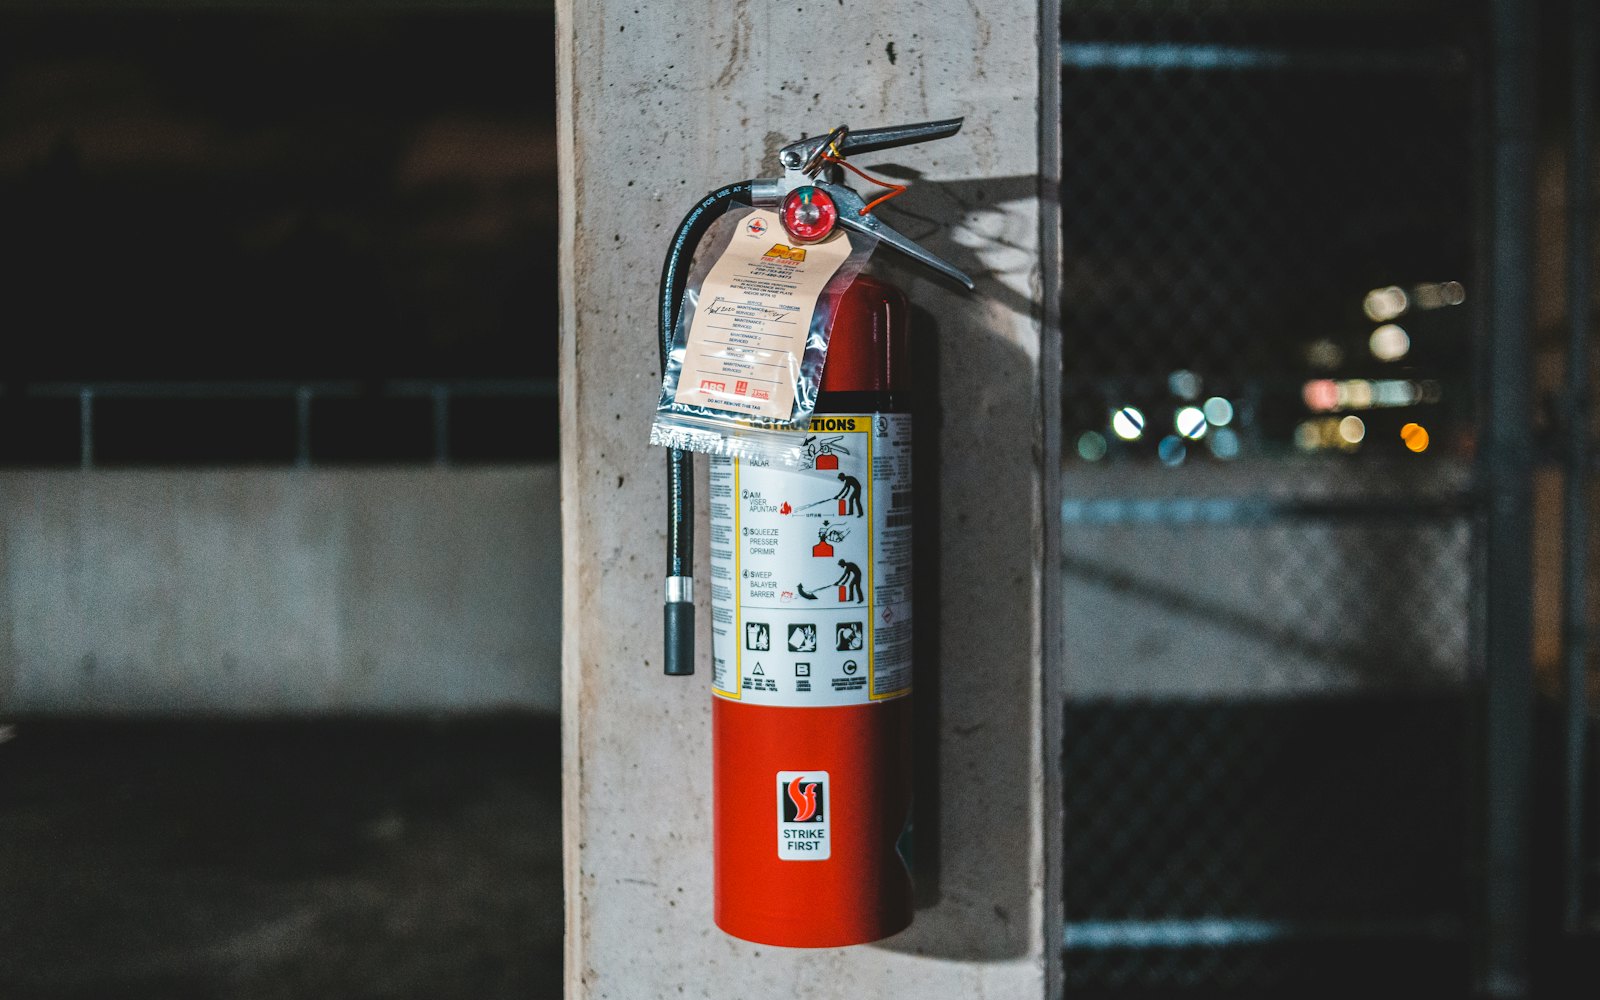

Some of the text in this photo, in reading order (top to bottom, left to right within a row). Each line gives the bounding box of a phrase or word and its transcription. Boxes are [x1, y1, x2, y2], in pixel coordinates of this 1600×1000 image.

[702, 196, 717, 208] FOR
[716, 188, 731, 199] USE
[702, 381, 724, 392] ABS
[750, 491, 761, 499] AIM
[750, 528, 779, 536] SQUEEZE
[750, 571, 772, 579] SWEEP
[796, 663, 810, 676] B
[783, 829, 825, 839] STRIKE
[788, 841, 821, 851] FIRST
